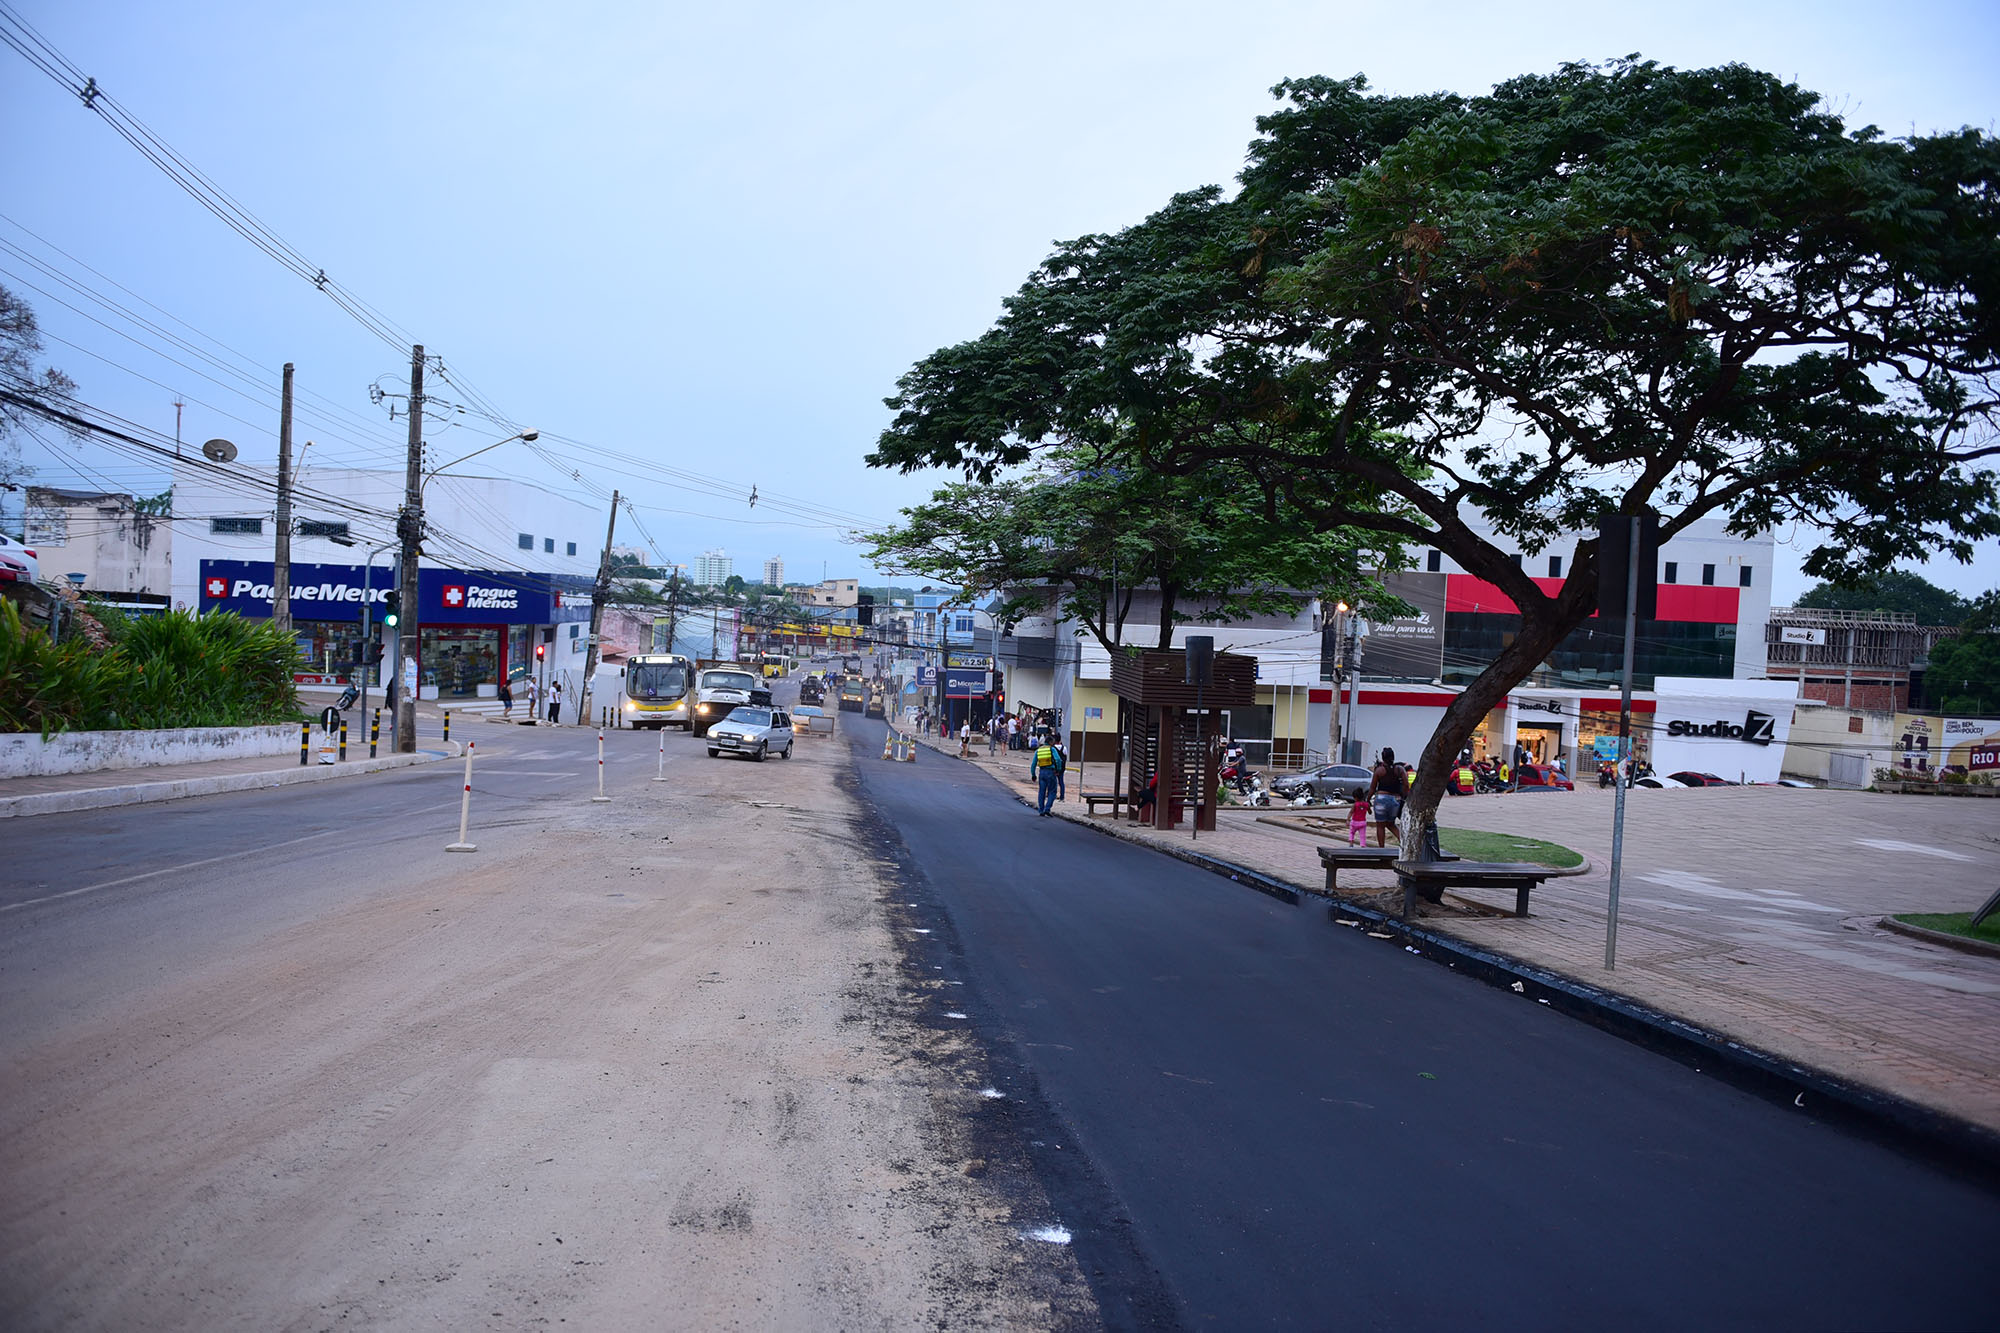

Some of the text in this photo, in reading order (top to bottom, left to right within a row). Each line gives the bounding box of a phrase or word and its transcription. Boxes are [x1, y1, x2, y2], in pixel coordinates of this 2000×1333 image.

[232, 580, 393, 603] PaueMeno
[467, 586, 517, 599] Pague
[466, 596, 518, 609] Menos
[1786, 631, 1814, 641] Studio Z
[1518, 700, 1561, 714] Studio Z
[1667, 711, 1775, 745] Studio Z
[1962, 727, 1983, 736] POUCO!
[1972, 752, 1994, 764] RIO
